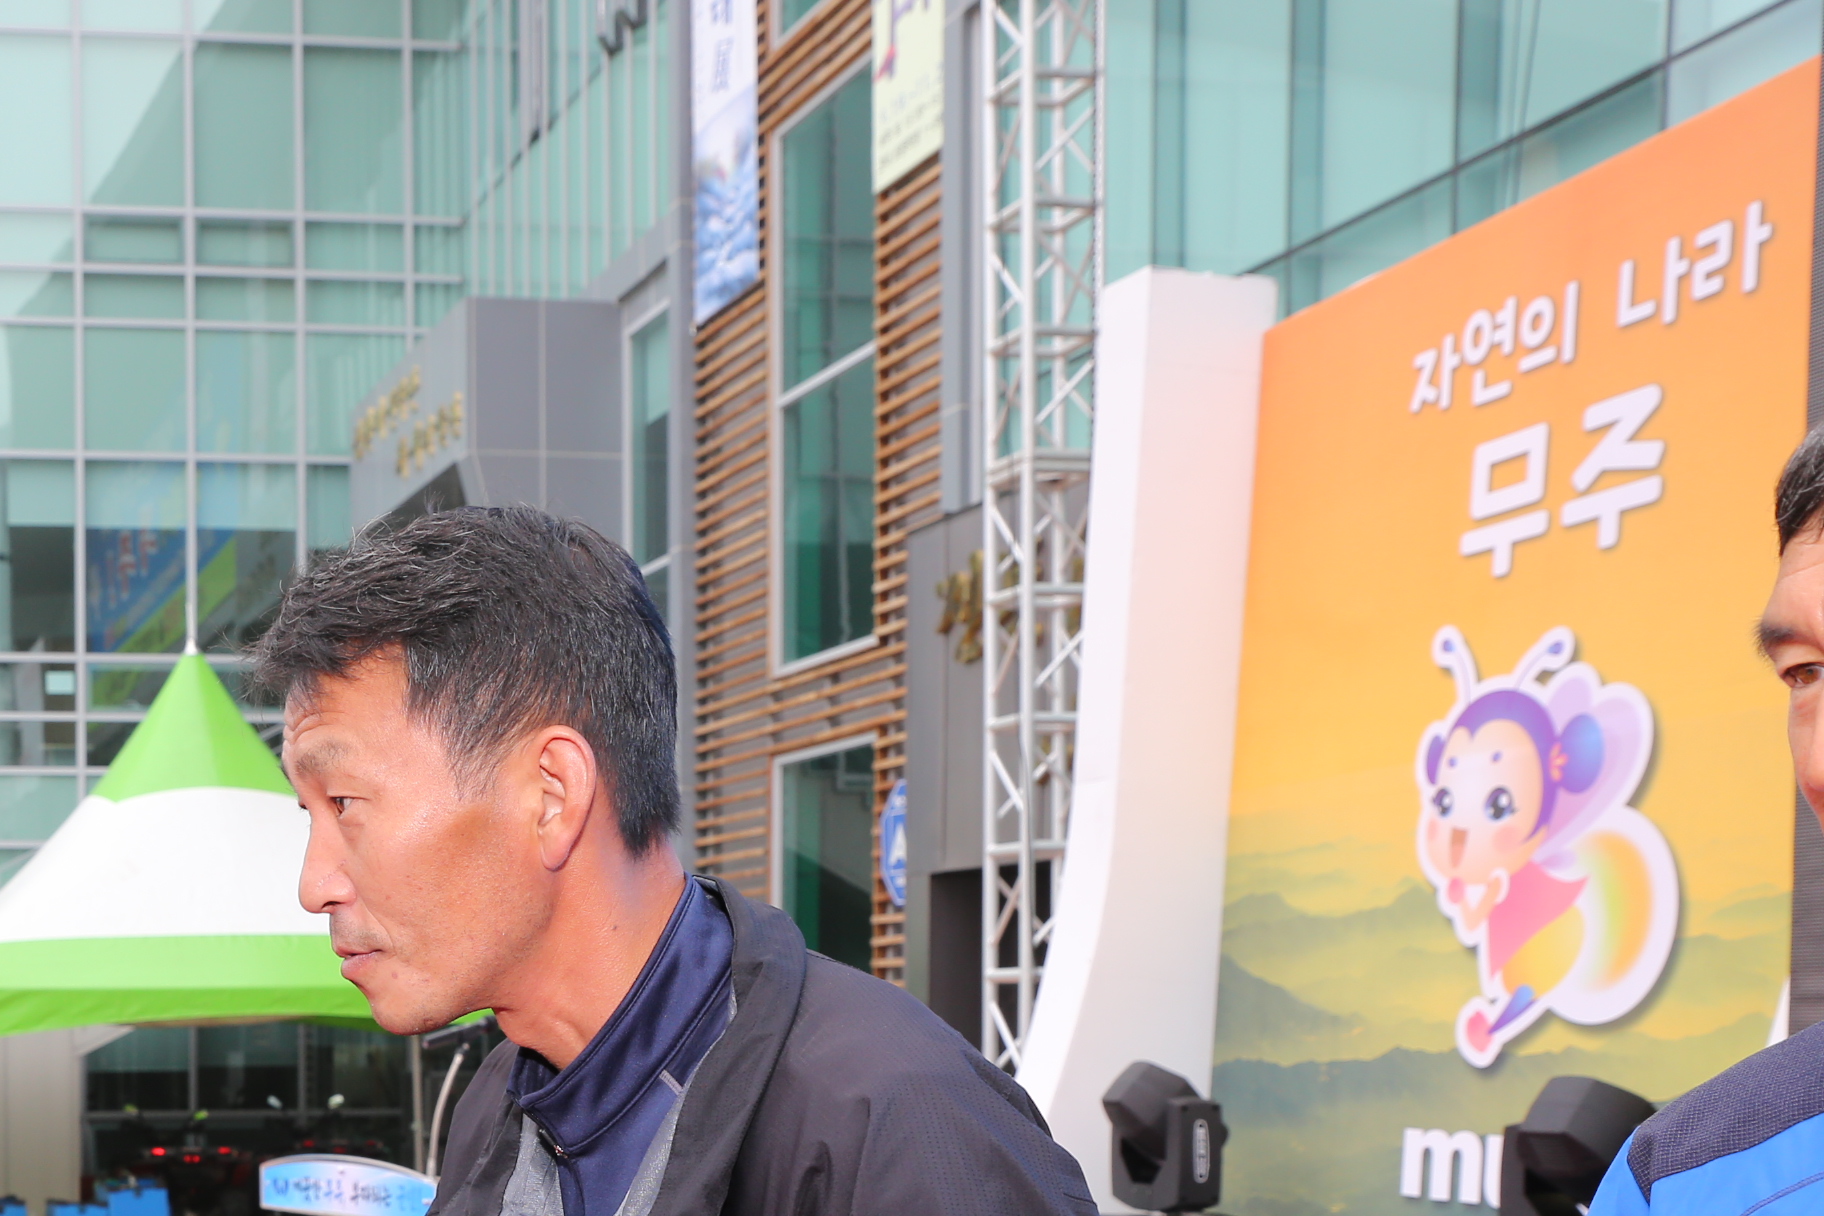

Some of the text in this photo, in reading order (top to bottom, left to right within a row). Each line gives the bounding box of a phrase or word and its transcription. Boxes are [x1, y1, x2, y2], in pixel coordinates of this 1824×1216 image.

[1409, 199, 1774, 413] 자연의 나라
[1459, 382, 1665, 578] 무주
